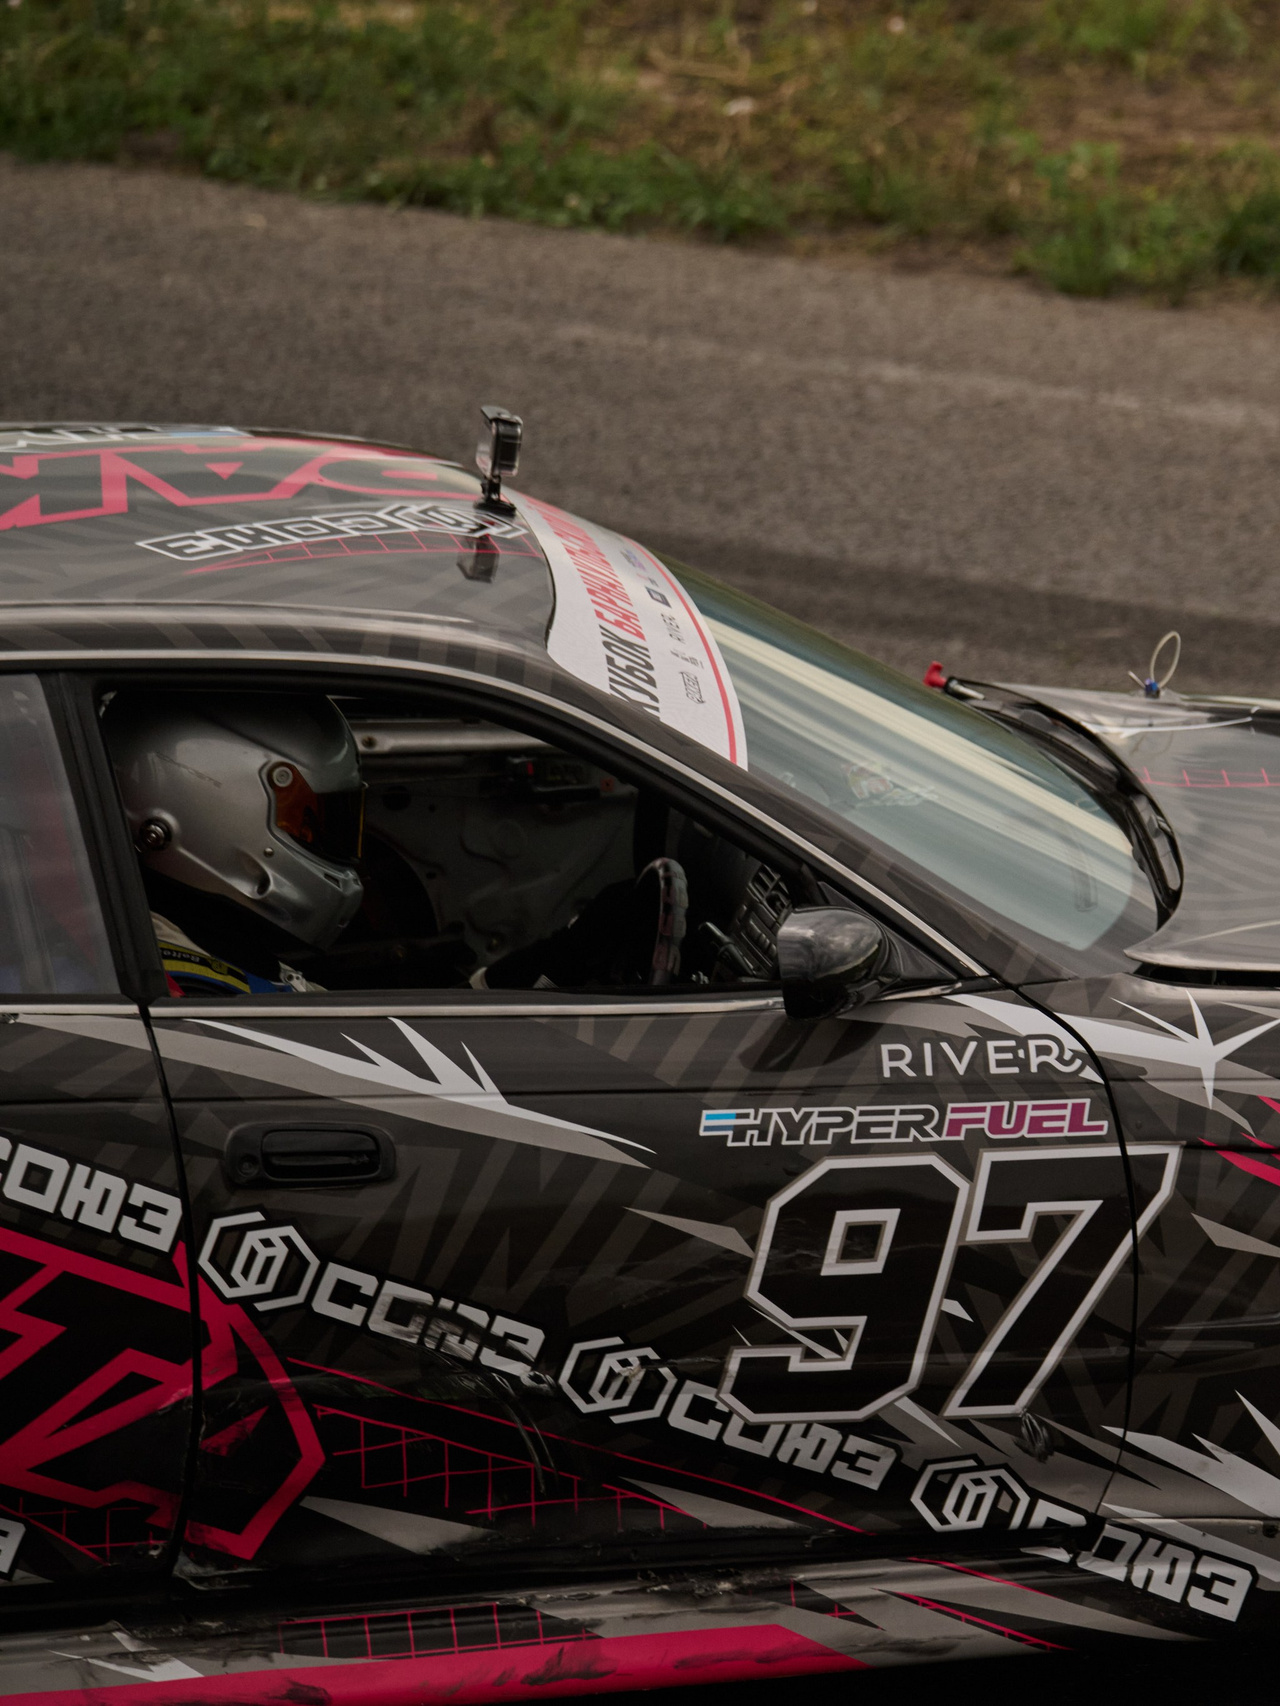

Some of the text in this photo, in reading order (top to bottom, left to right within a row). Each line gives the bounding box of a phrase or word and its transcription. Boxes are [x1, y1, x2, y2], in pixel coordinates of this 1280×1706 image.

[598, 624, 661, 720] КУБОК
[880, 1039, 1082, 1078] RIVER
[0, 1136, 183, 1253] ОЮЗ
[717, 1142, 1187, 1426] 97
